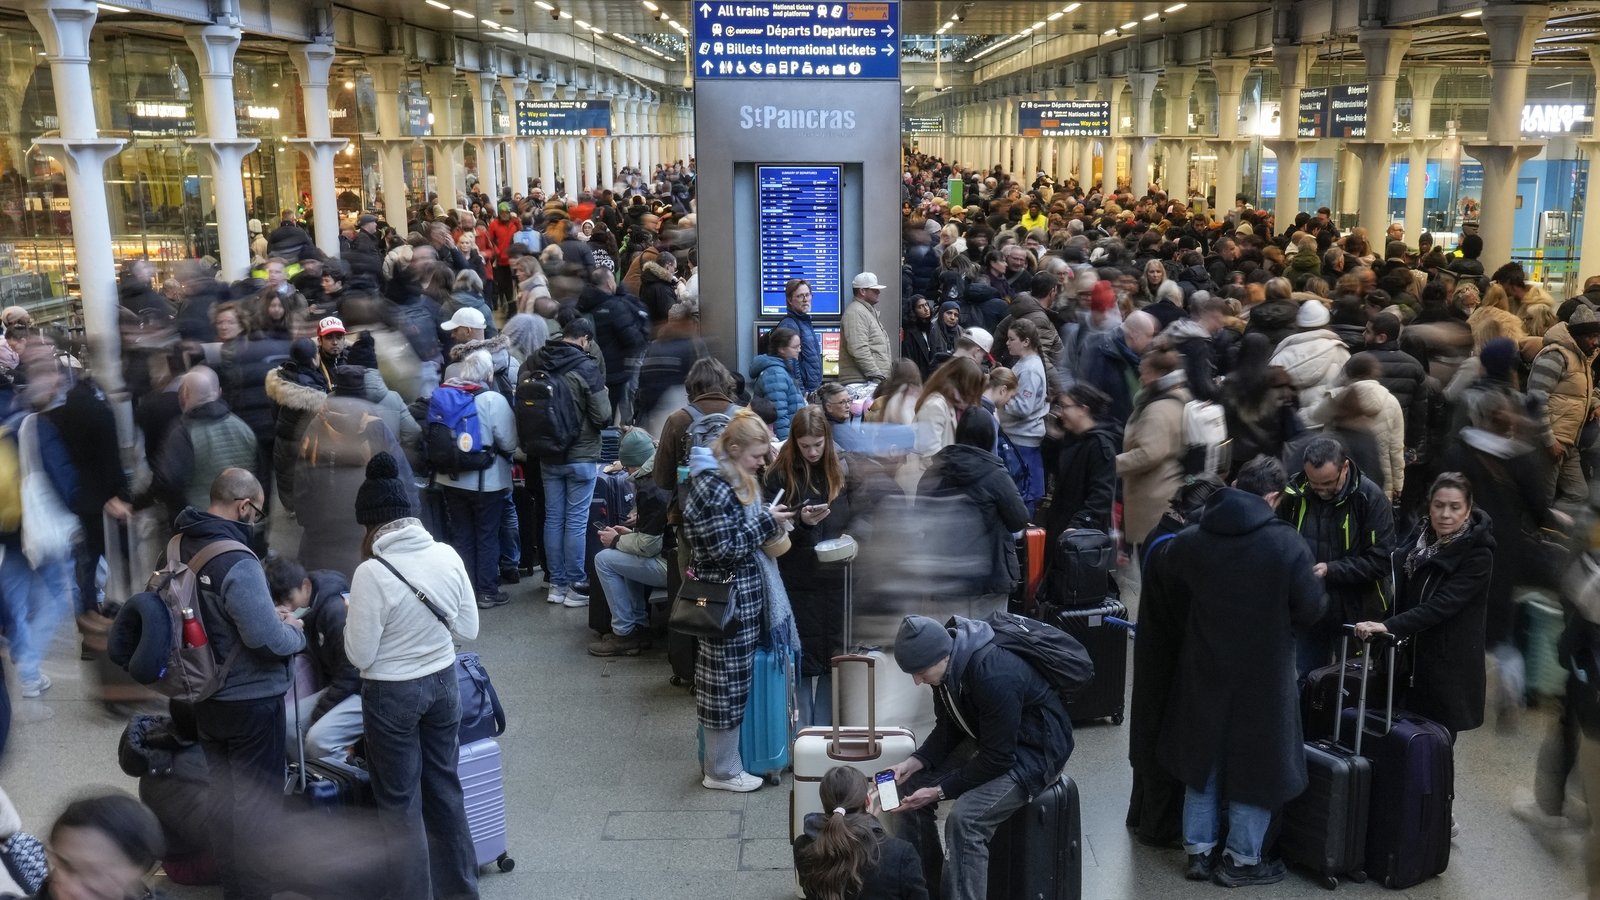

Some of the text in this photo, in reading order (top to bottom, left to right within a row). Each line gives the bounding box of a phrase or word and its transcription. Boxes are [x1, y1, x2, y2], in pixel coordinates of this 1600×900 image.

[718, 5, 770, 17] All trains
[766, 24, 876, 39] Départs Departures
[726, 43, 877, 55] Billets International tickets
[1520, 117, 1575, 132] ONEY
